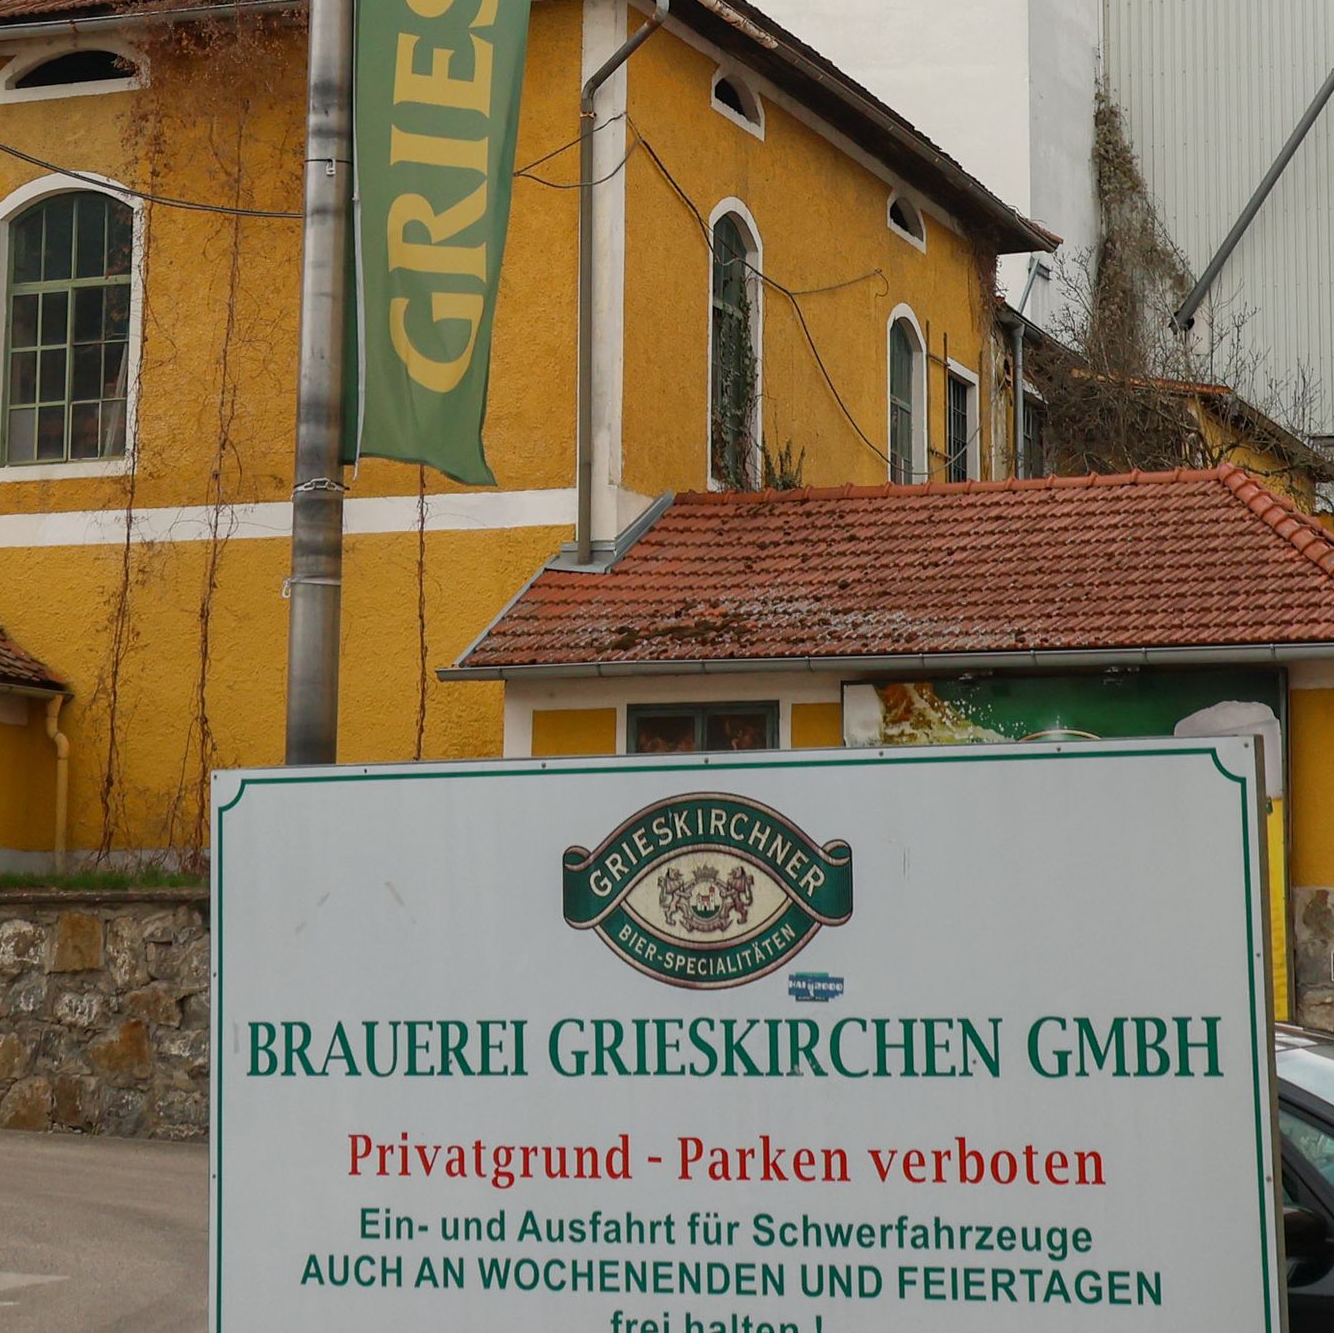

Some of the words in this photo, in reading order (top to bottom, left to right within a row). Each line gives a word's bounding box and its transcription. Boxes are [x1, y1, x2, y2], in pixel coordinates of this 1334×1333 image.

[589, 808, 826, 898] GRIESKIRCHNER
[618, 923, 797, 976] BIER-SPECIALITÄTEN
[246, 1019, 529, 1078] BRAUEREI
[548, 1016, 1003, 1078] GRIESKIRCHEN
[1026, 1015, 1225, 1078] GMBH
[347, 1131, 633, 1190] Privatgrund
[677, 1134, 851, 1182] Parken
[867, 1136, 1107, 1186] verboten
[359, 1207, 428, 1240] Ein-
[440, 1209, 506, 1242] und
[517, 1210, 676, 1245] Ausfahrt
[687, 1212, 740, 1246] für
[752, 1213, 1093, 1261] Schwerfahrzeuge
[301, 1253, 403, 1287] AUCH
[414, 1256, 465, 1290] AN
[478, 1258, 786, 1297] WOCHENENDEN
[801, 1264, 884, 1299] UND
[897, 1266, 1164, 1306] FEIERTAGEN
[610, 1311, 670, 1333] frei
